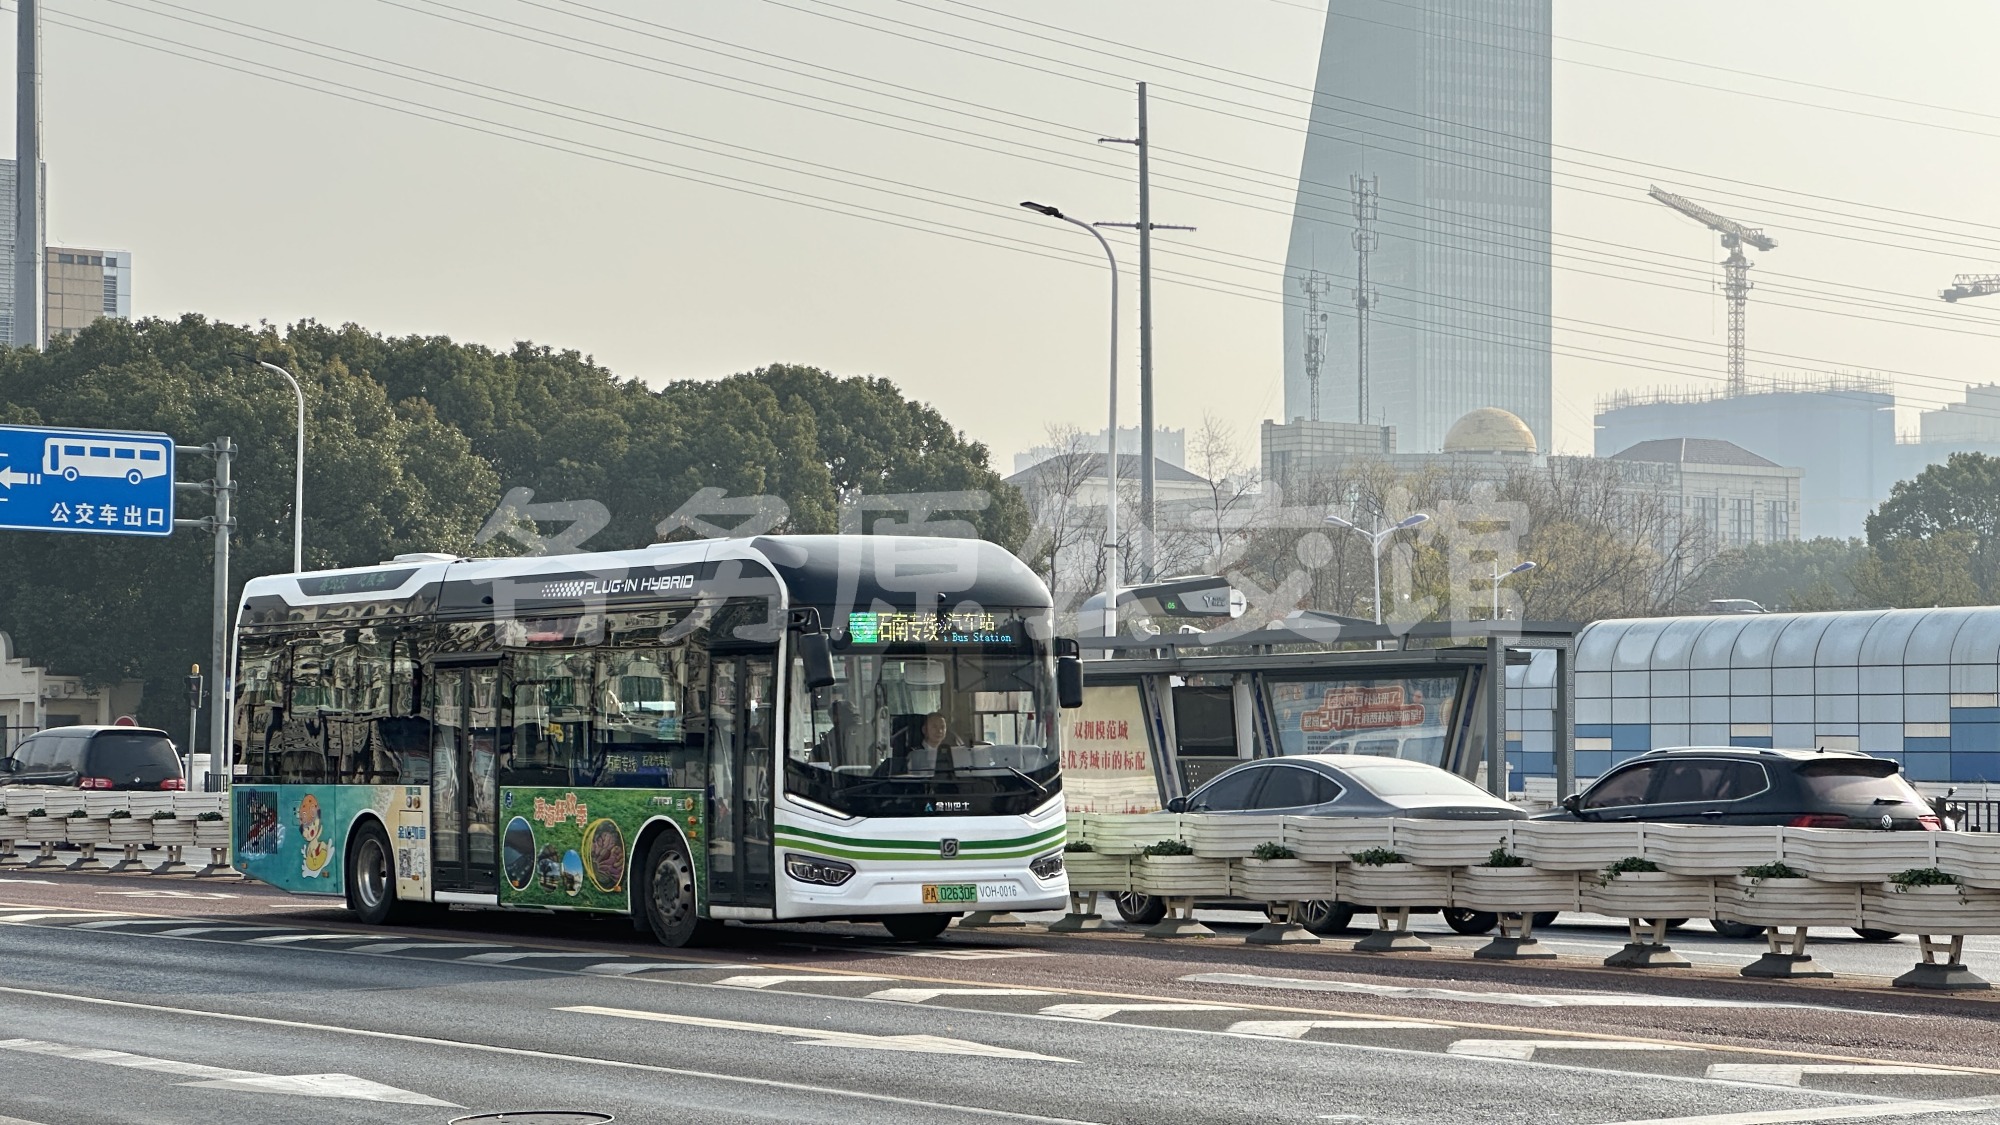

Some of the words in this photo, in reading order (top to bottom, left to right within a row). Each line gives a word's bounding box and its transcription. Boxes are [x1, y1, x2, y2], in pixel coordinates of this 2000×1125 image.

[50, 502, 164, 527] 公交车出口
[640, 574, 694, 591] HYBRID
[877, 612, 939, 642] 石南专线
[951, 632, 969, 642] Bus
[973, 632, 1012, 642] Station
[1074, 720, 1128, 740] 双拥模范城
[935, 801, 970, 811] 金山巴士
